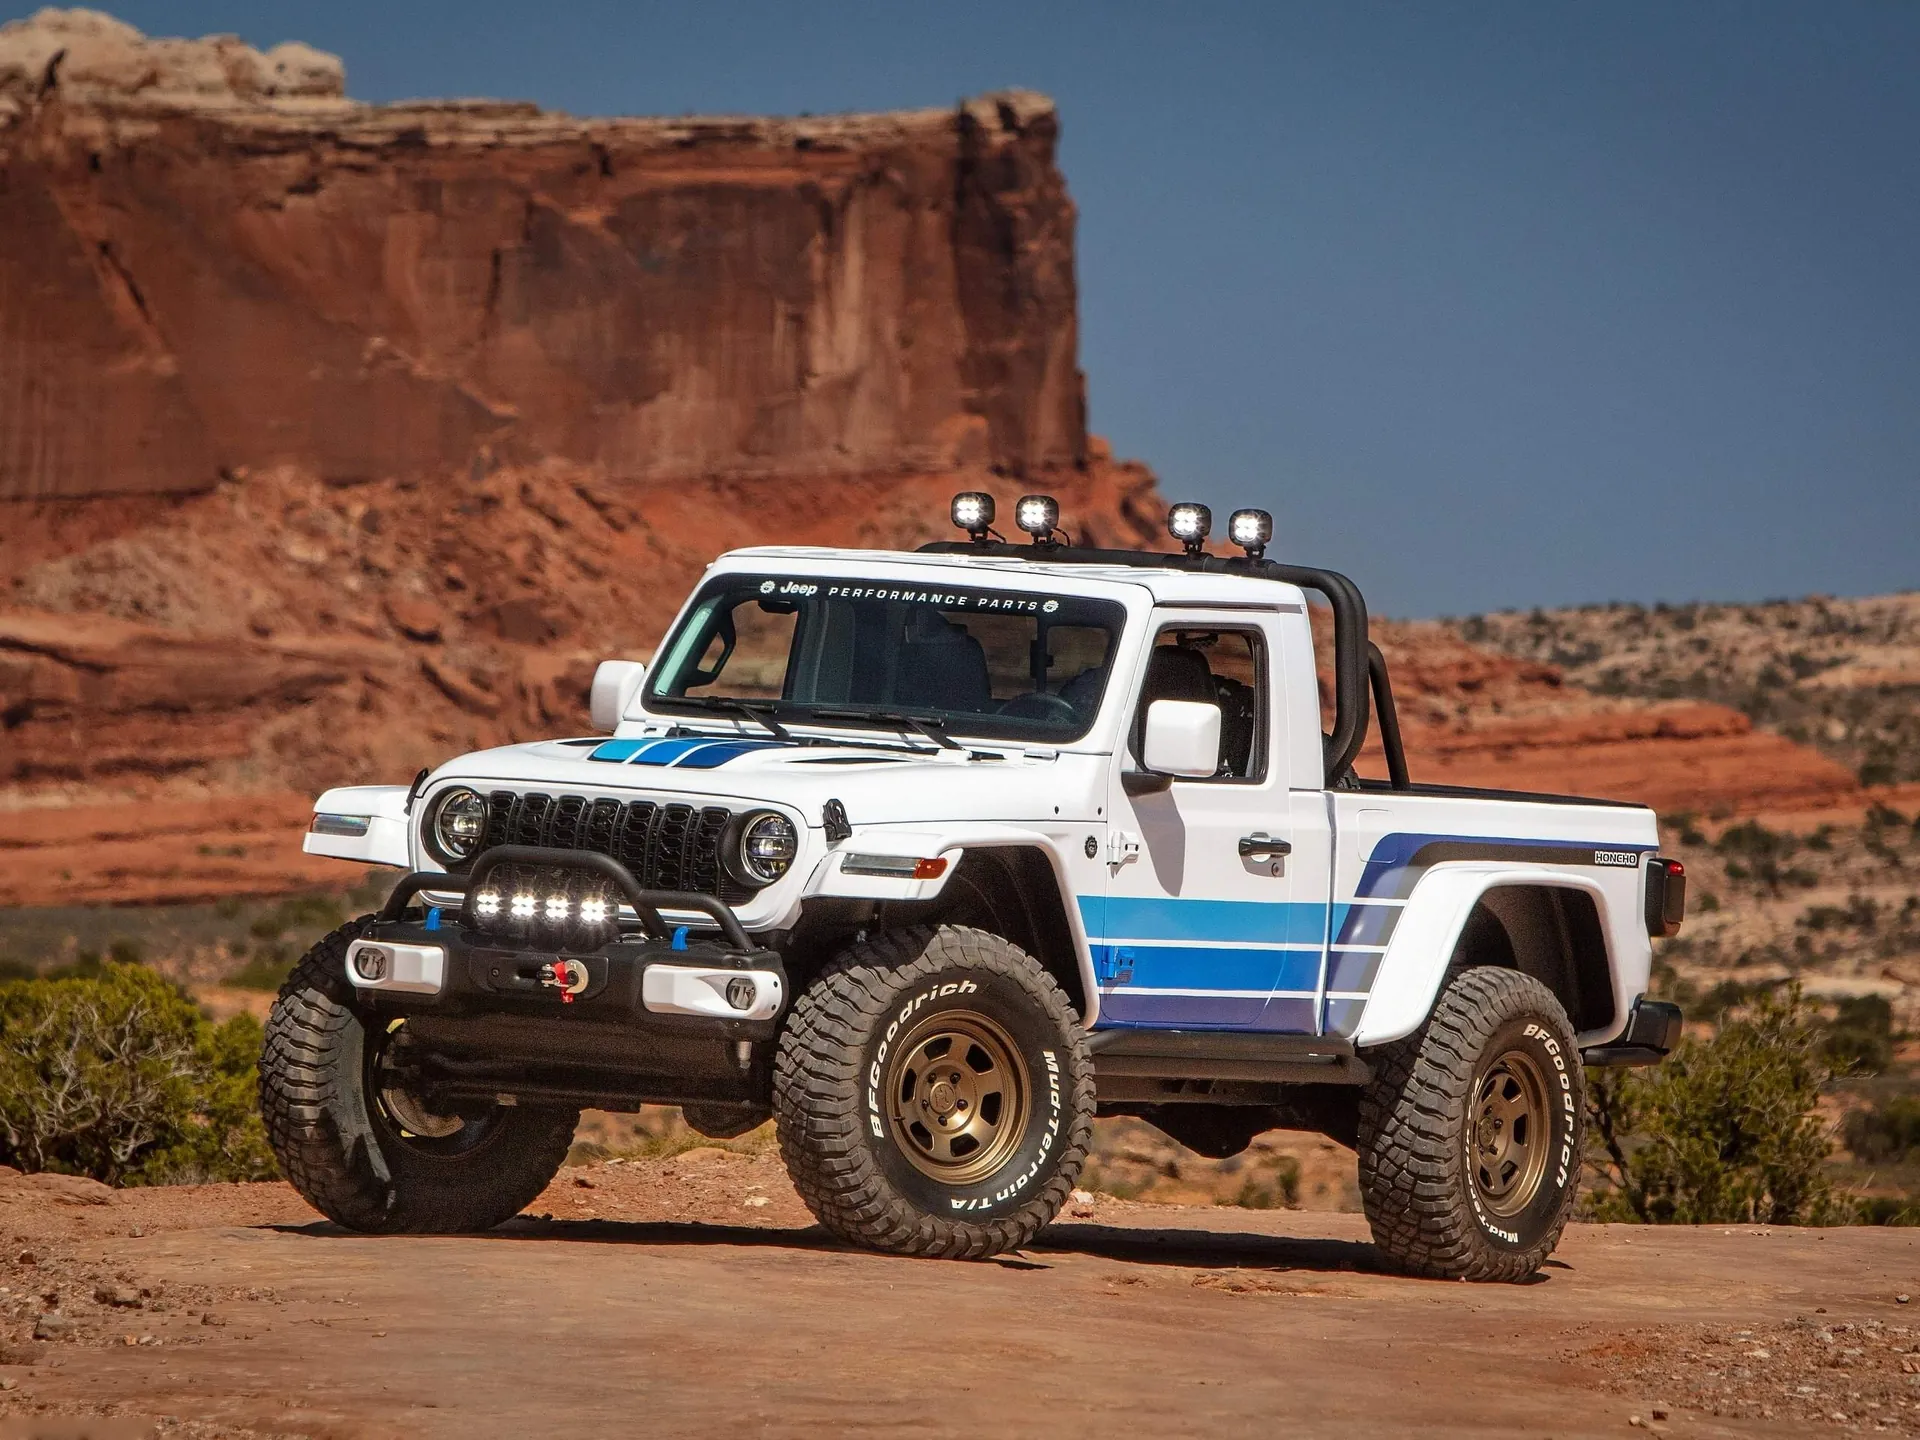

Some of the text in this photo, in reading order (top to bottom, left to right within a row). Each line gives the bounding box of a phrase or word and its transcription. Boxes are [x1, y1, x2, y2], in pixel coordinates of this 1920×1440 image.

[780, 581, 1037, 611] Jeep PERFORMANCE PARTS
[1595, 851, 1637, 865] HONCHO
[868, 980, 978, 1138] BFGoodrich
[951, 1051, 1061, 1211] Mud-Terrain T/A
[1523, 1023, 1575, 1189] BFGoodrich
